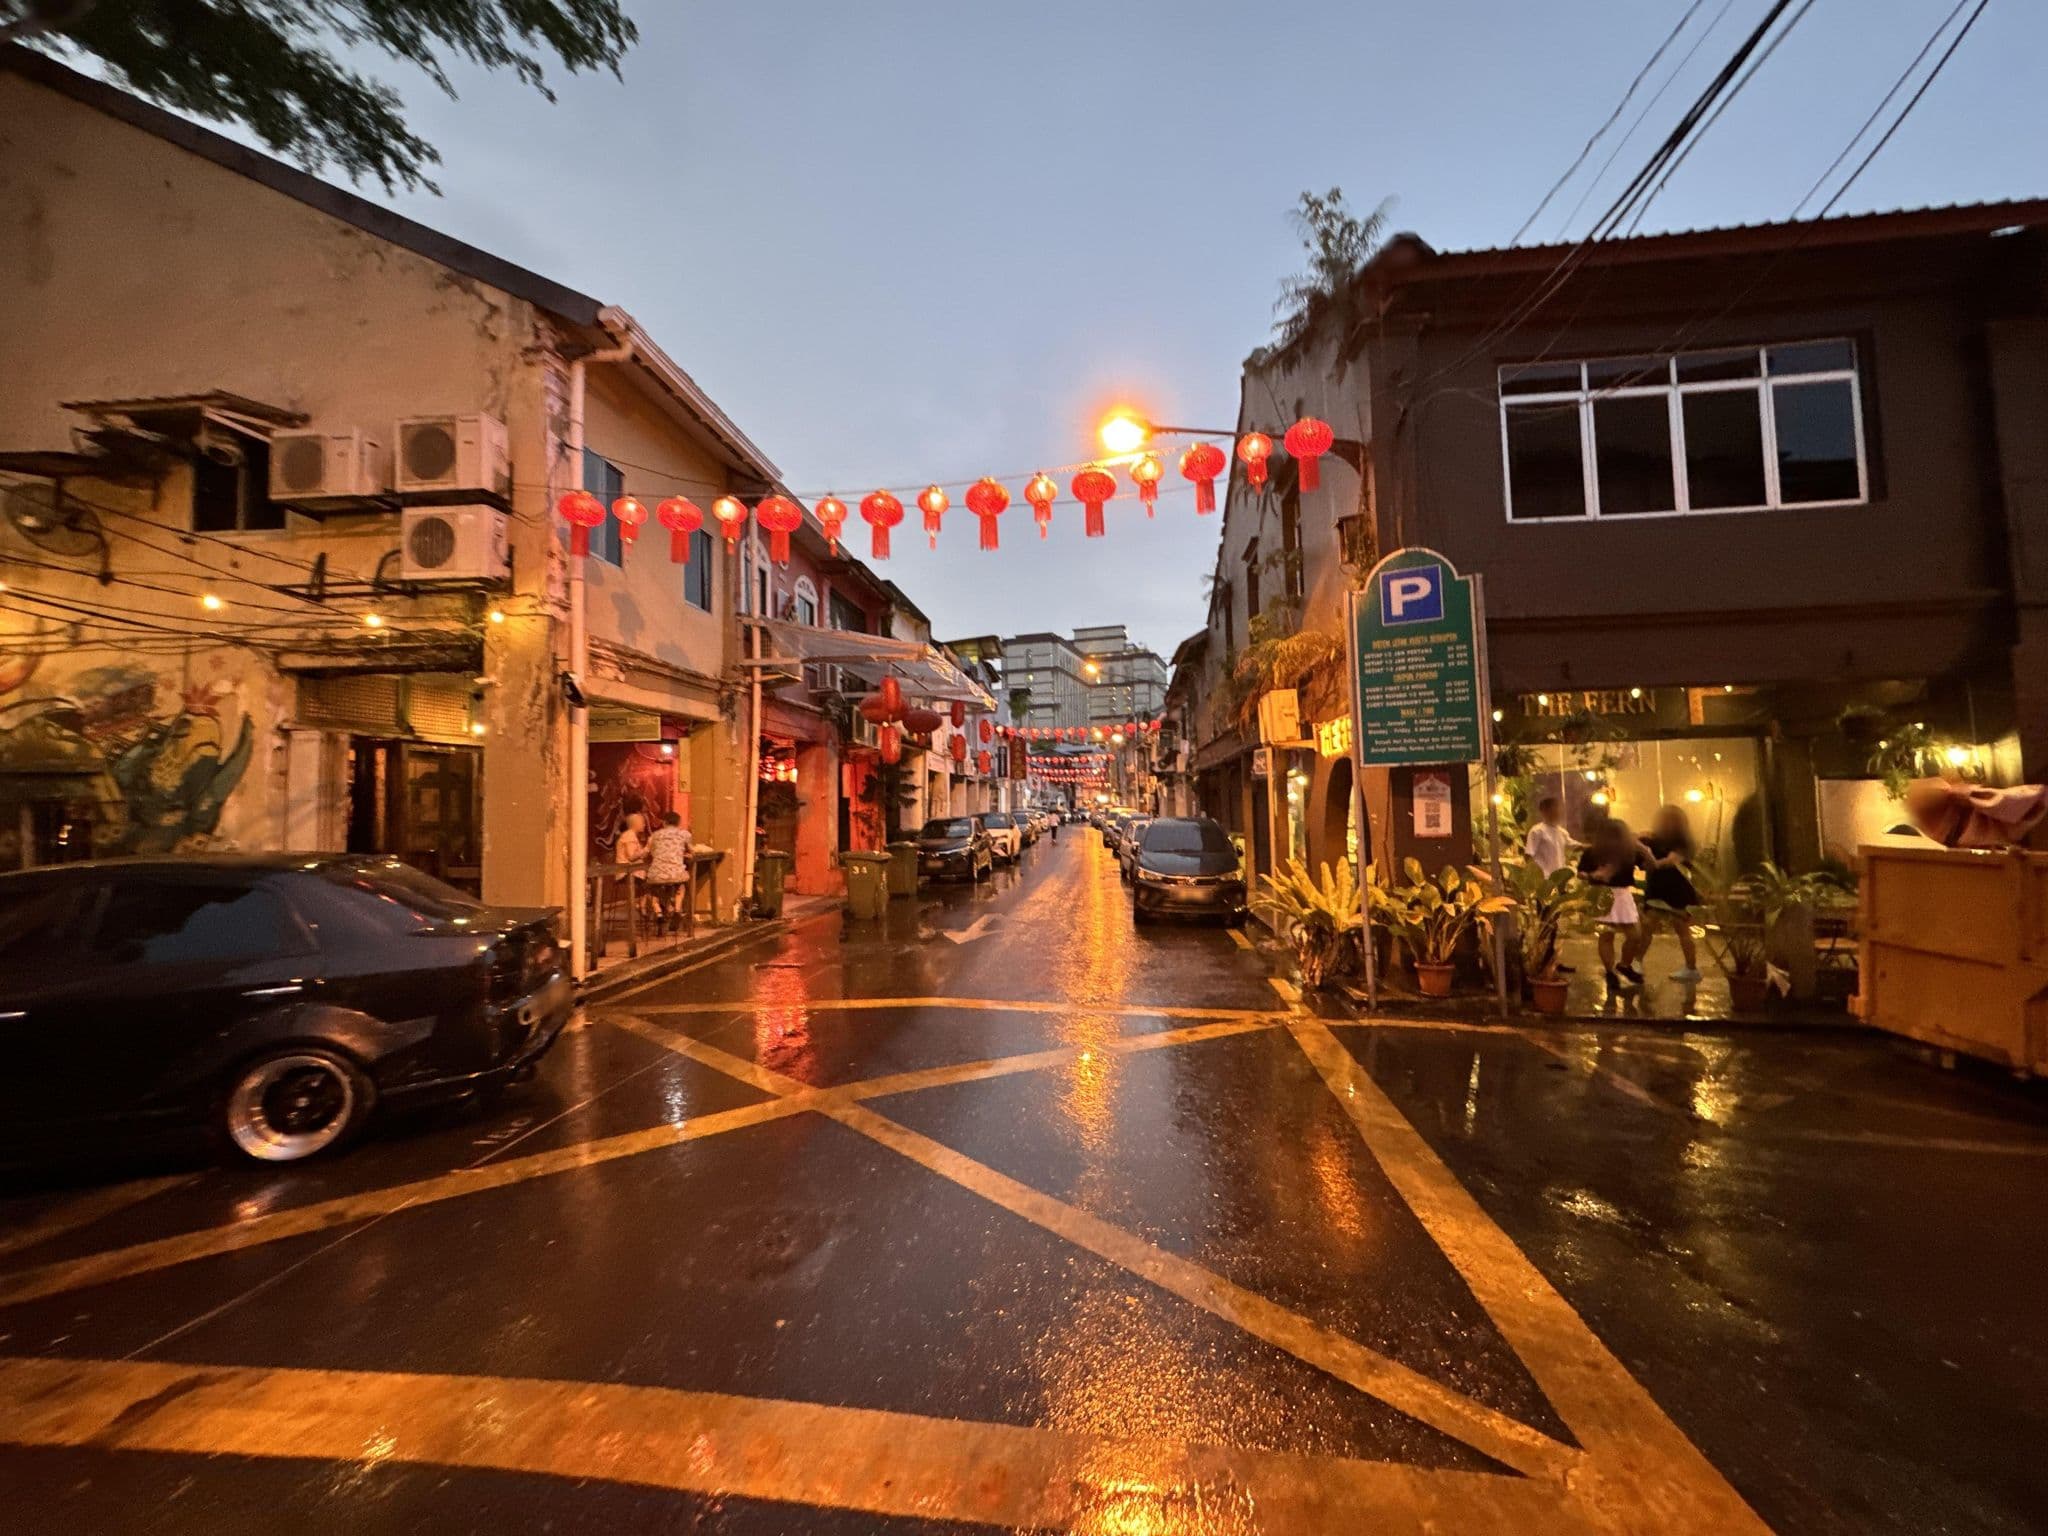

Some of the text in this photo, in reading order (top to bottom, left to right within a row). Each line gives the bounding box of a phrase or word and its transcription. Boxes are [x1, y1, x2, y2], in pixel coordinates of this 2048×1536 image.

[1389, 576, 1432, 617] P
[1518, 689, 1657, 717] THE FERN
